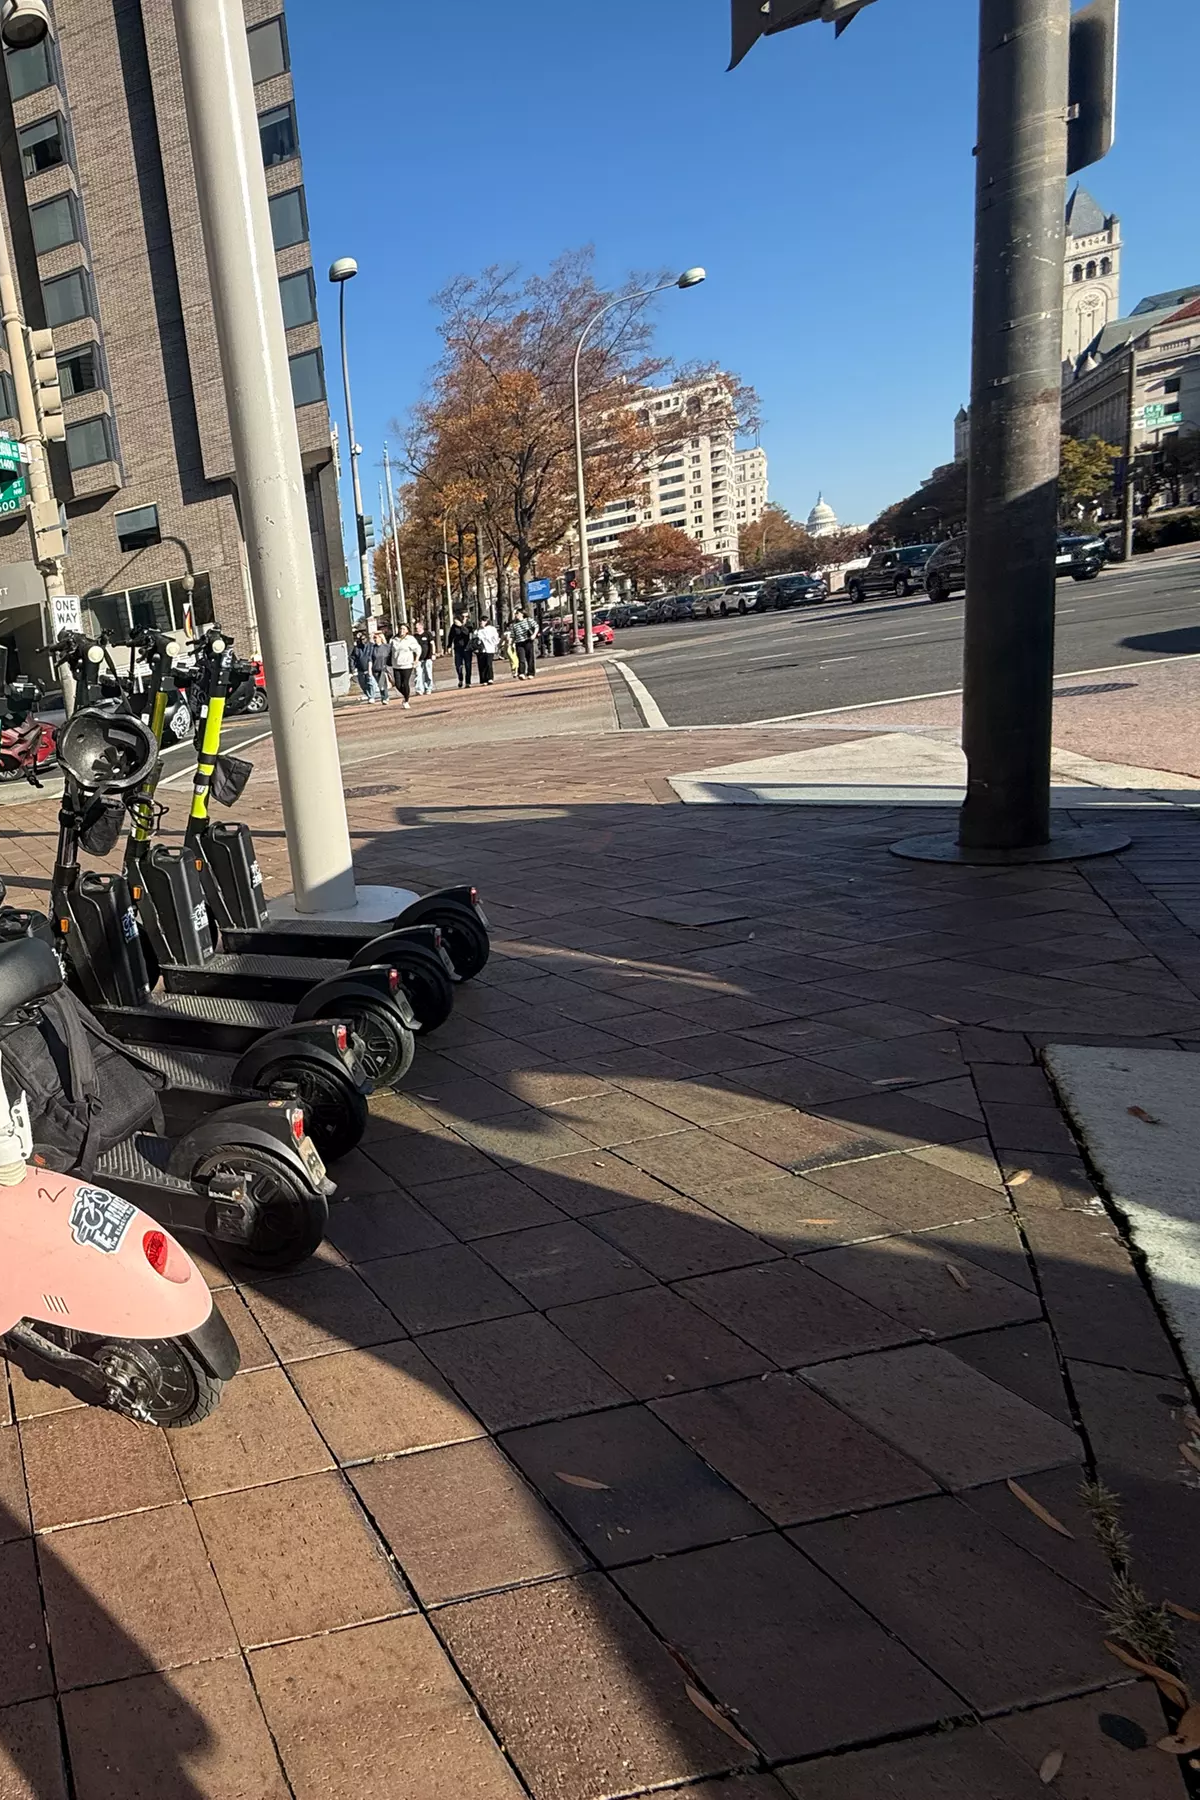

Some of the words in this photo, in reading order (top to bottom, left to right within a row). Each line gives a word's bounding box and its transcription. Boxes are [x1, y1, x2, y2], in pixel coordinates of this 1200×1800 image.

[12, 480, 22, 488] ST
[13, 487, 23, 496] NW
[55, 600, 77, 611] ONE
[56, 613, 78, 624] WAY
